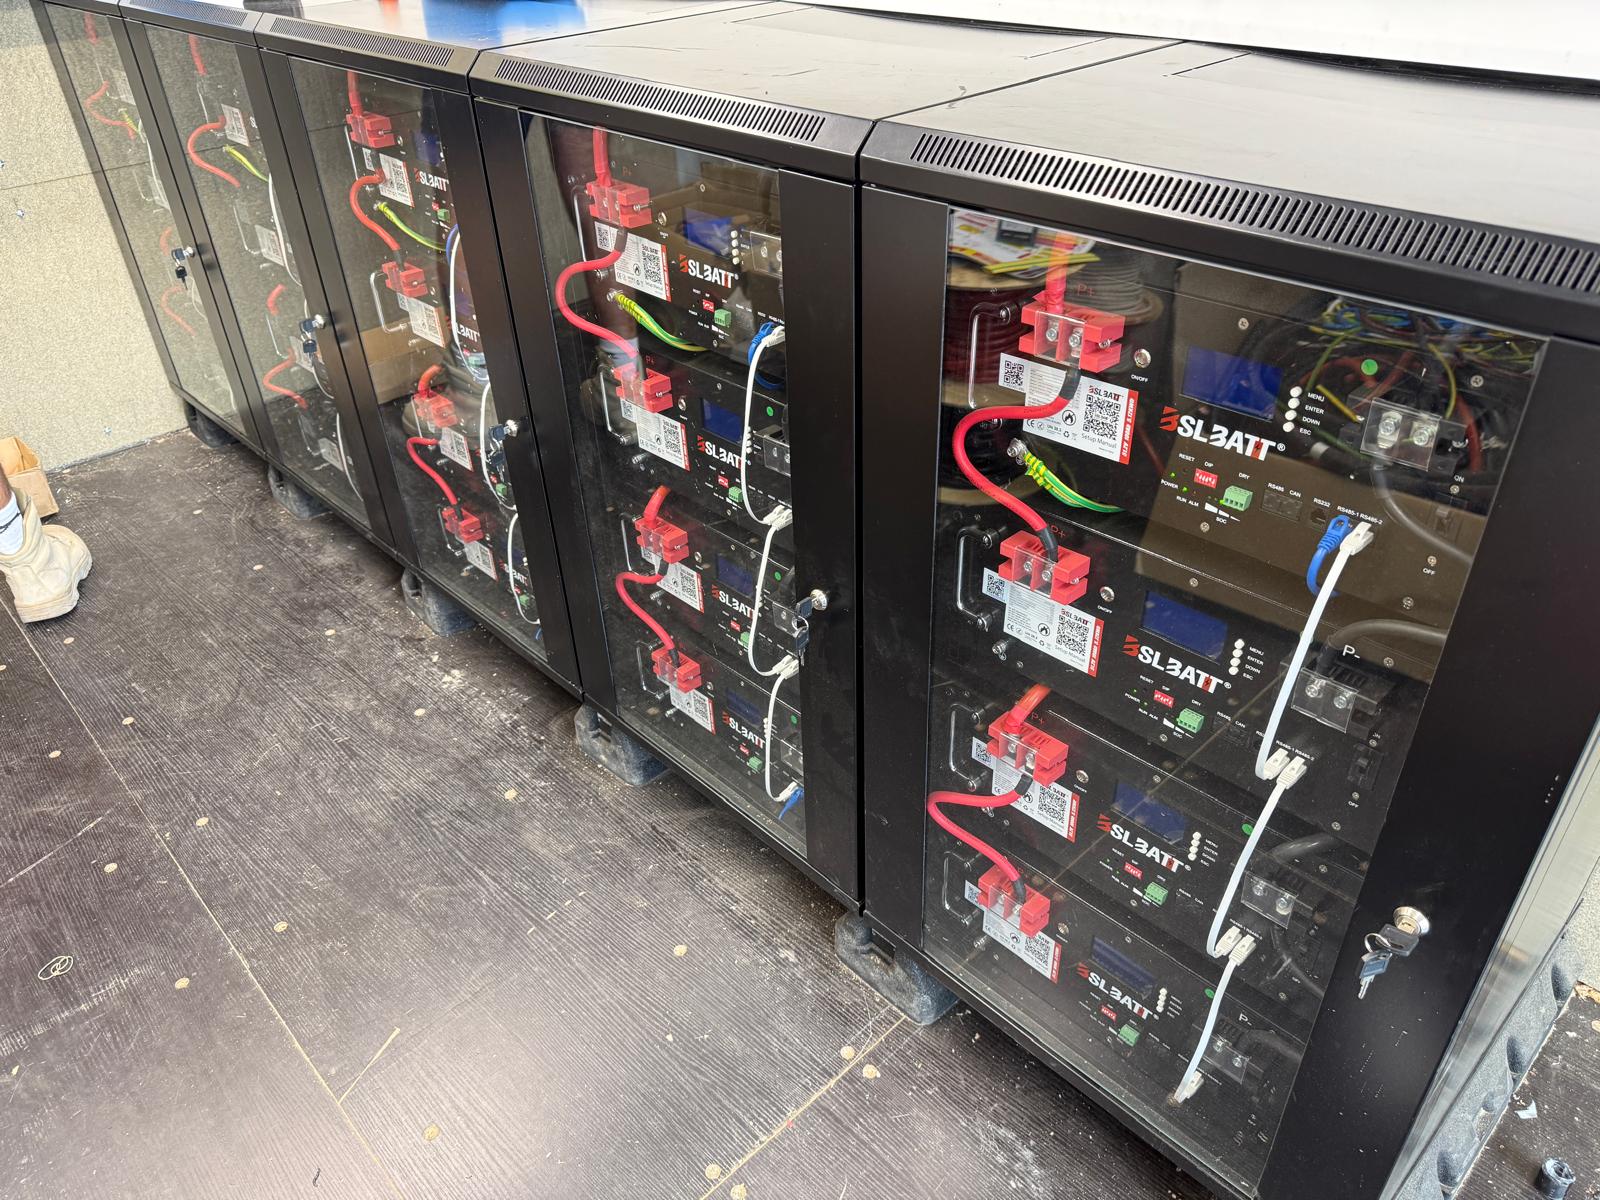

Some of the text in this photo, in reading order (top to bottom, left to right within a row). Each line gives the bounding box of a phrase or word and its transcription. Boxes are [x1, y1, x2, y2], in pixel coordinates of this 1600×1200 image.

[1308, 392, 1325, 402] MENU
[1305, 405, 1324, 415] ENTER
[1302, 416, 1321, 426] DOWN
[1299, 427, 1312, 436] ESC
[1179, 453, 1195, 462] RESET
[1238, 472, 1250, 480] DRY
[1453, 474, 1465, 483] ON
[1160, 478, 1179, 490] POWER
[1268, 483, 1302, 498] RS485 CAN
[1176, 495, 1199, 507] RUN ALM
[1313, 497, 1331, 508] RS232
[1337, 505, 1383, 525] RS485-1 RS485-2
[1215, 516, 1227, 525] SOC
[1422, 567, 1436, 576] OFF
[1249, 647, 1265, 656] MENU
[1342, 645, 1360, 659] P-
[1247, 655, 1264, 665] ENTER
[1245, 664, 1261, 674] DOWN
[1235, 720, 1245, 728] CAN
